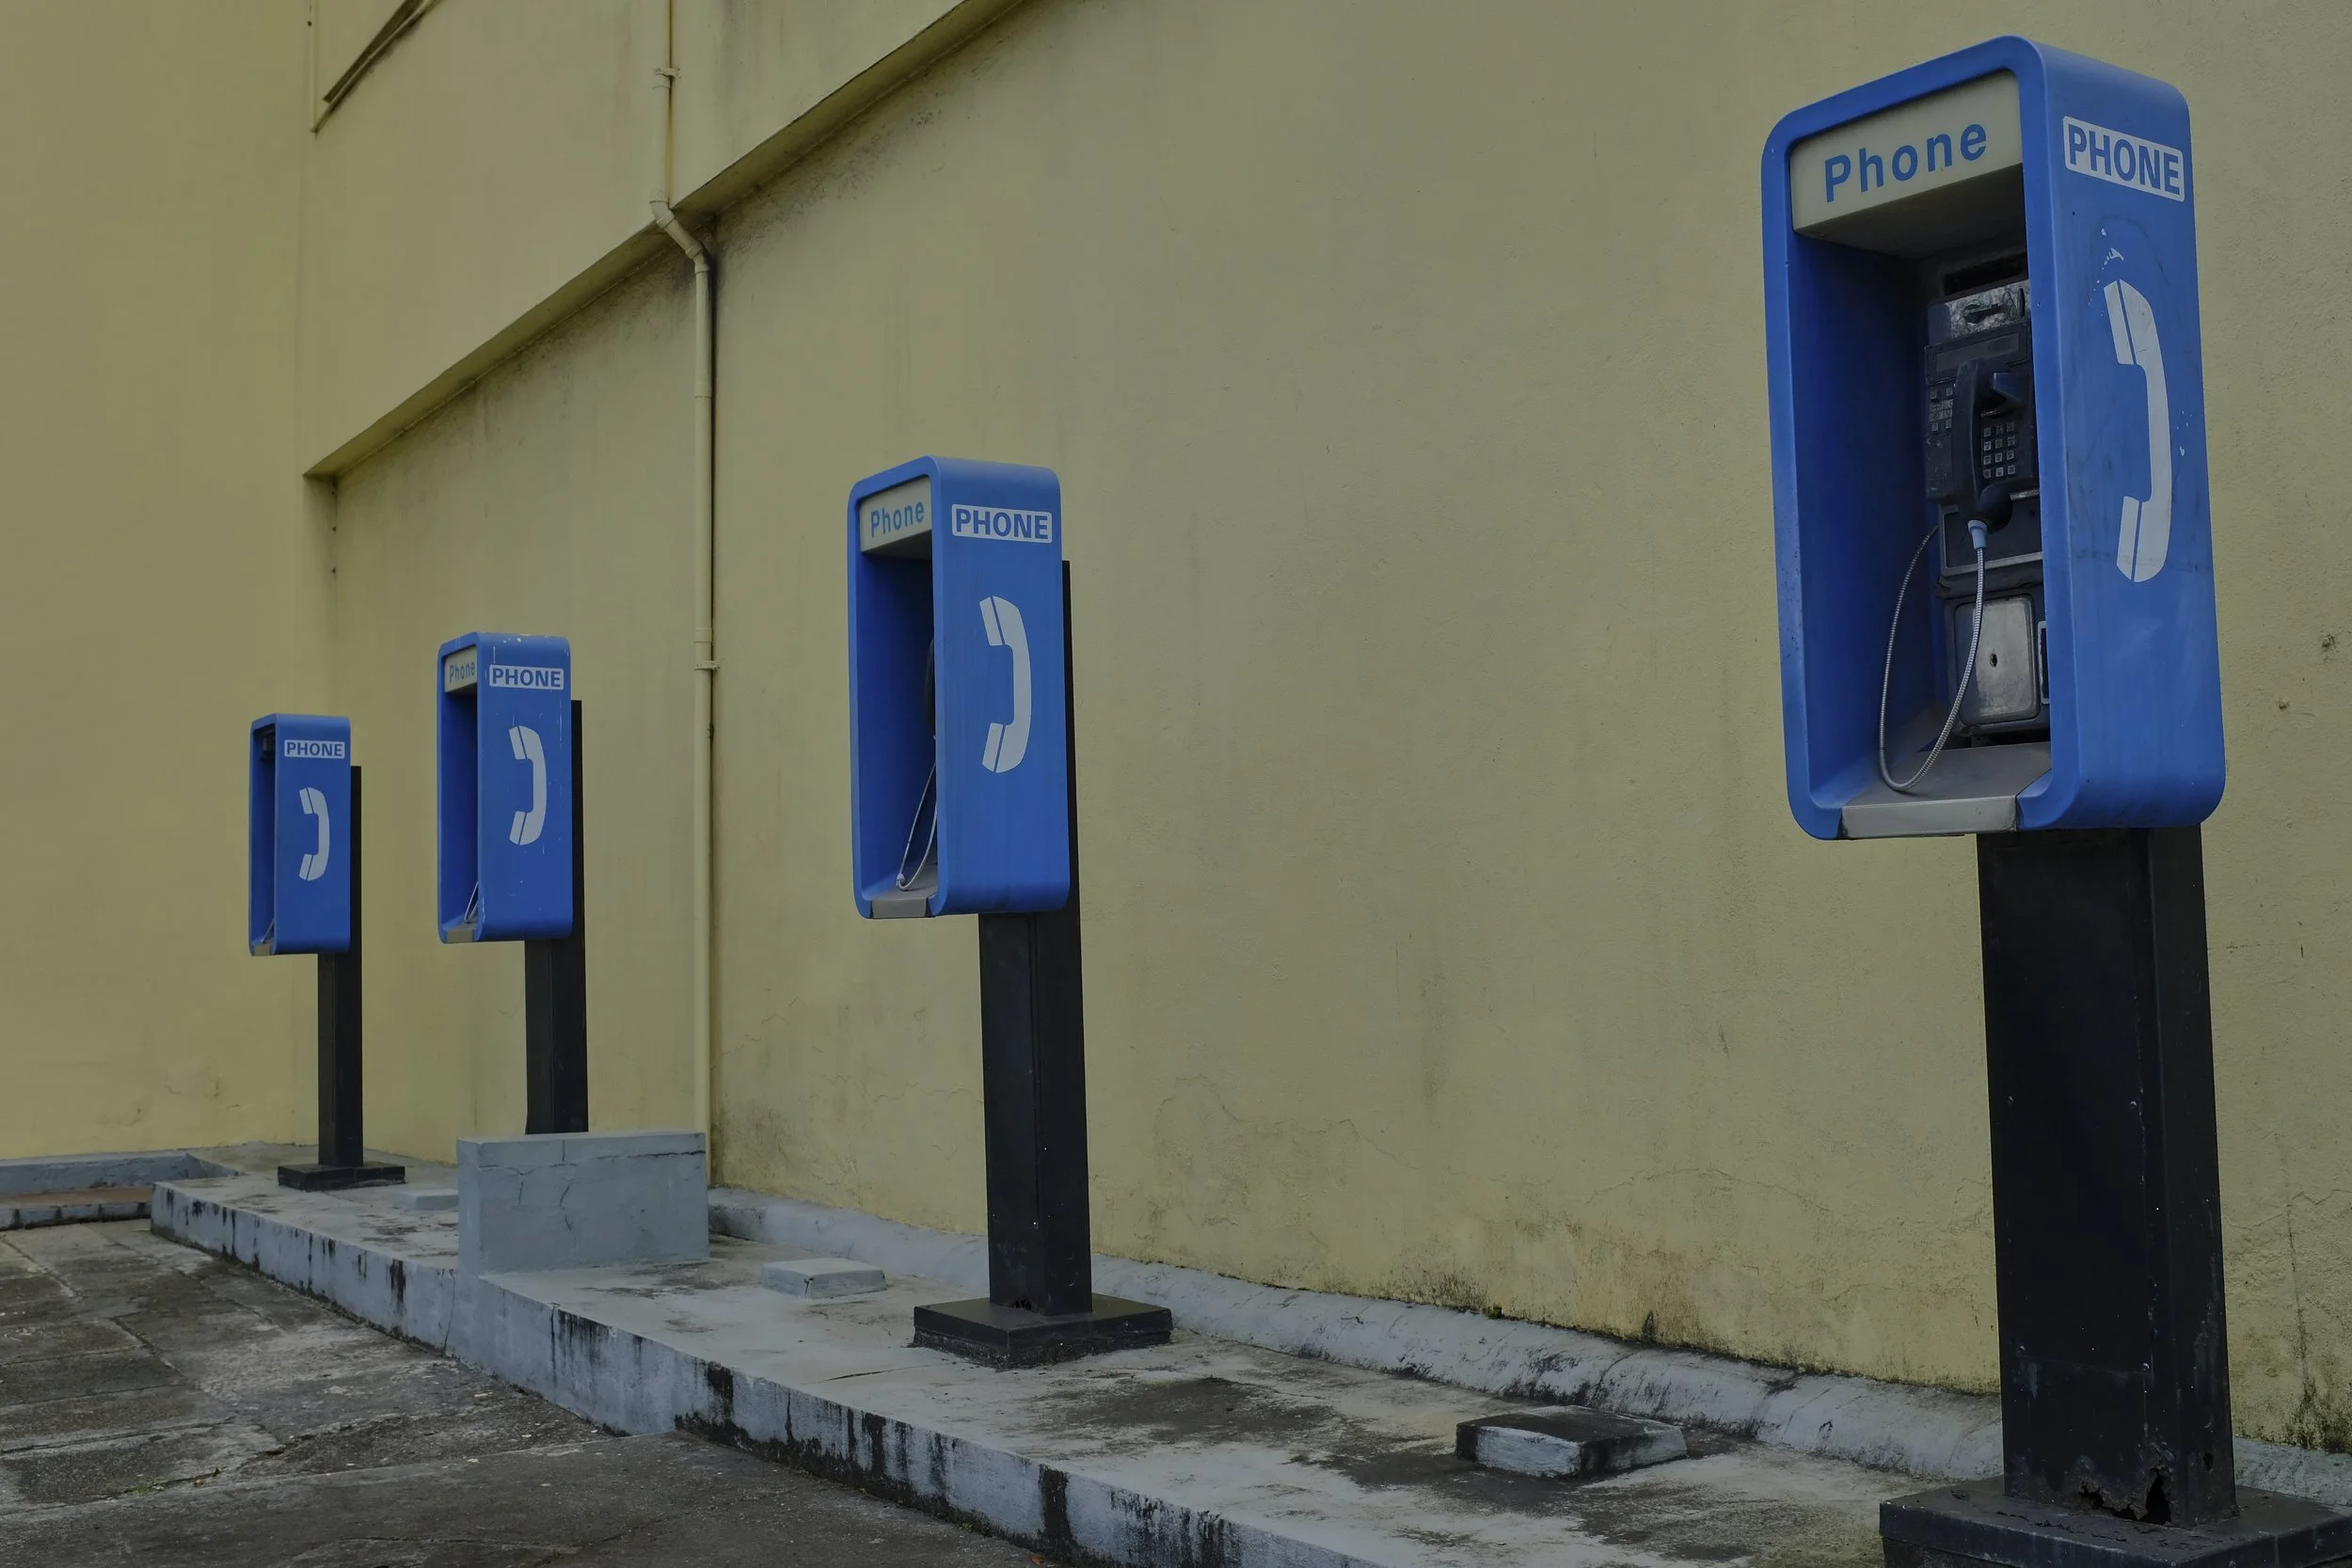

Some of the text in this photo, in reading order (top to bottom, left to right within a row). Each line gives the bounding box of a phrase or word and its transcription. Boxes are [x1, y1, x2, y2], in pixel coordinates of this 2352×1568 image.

[1824, 123, 1988, 203] Phone
[2068, 123, 2182, 196] PHONE
[870, 500, 925, 538] Phone
[955, 508, 1049, 540] PHONE
[449, 661, 476, 683] Phone
[492, 667, 562, 688] PHONE
[286, 741, 343, 757] PHONE
